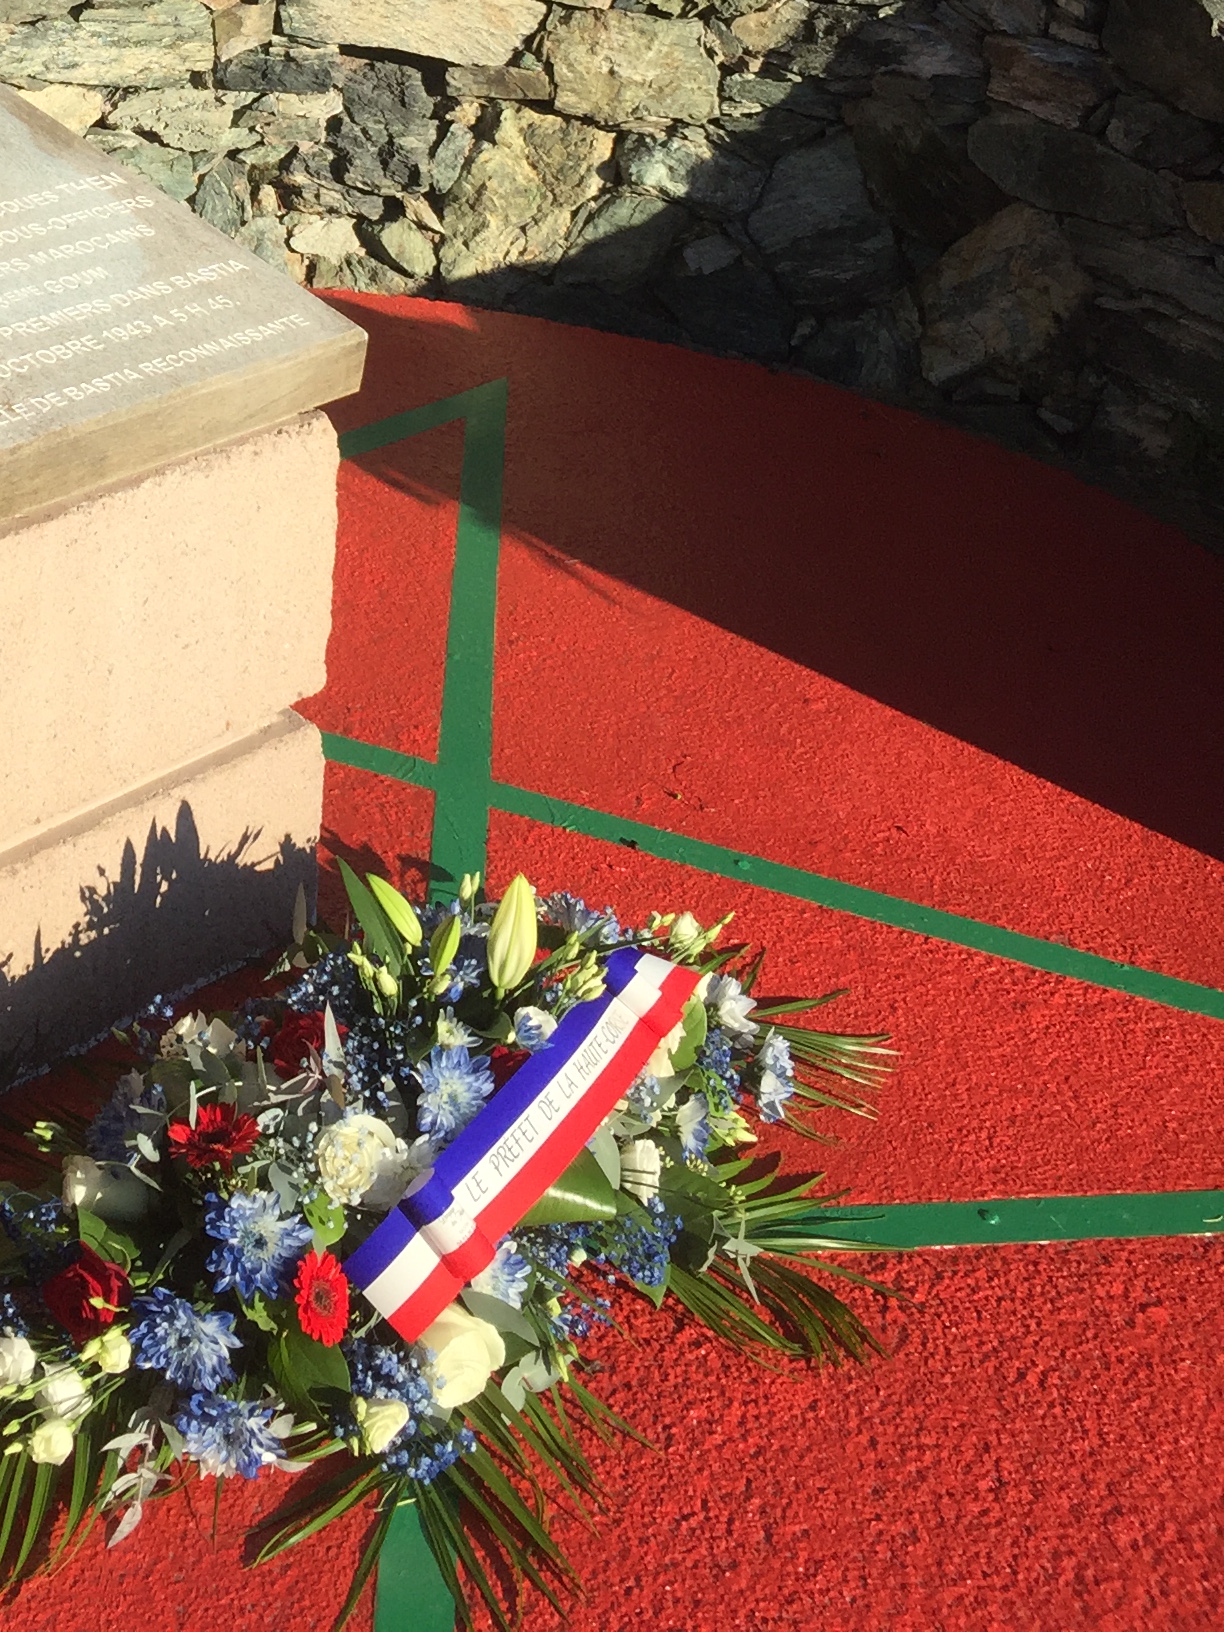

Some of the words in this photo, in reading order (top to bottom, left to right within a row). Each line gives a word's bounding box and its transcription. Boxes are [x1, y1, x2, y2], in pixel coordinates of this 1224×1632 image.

[55, 172, 127, 196] THEN
[29, 224, 156, 265] MAROCAINS
[43, 267, 109, 294] GOUM
[110, 281, 173, 308] DANS
[170, 259, 249, 289] BASTIA
[102, 320, 152, 342] 1943
[153, 314, 174, 328] A
[170, 308, 188, 322] 5
[187, 302, 209, 316] H
[30, 392, 68, 413] DE
[63, 368, 144, 401] BASTIA
[138, 313, 311, 377] RECONNAISSANTE
[464, 1171, 489, 1203] LE
[537, 1091, 561, 1121] DE
[556, 1074, 578, 1100] LA
